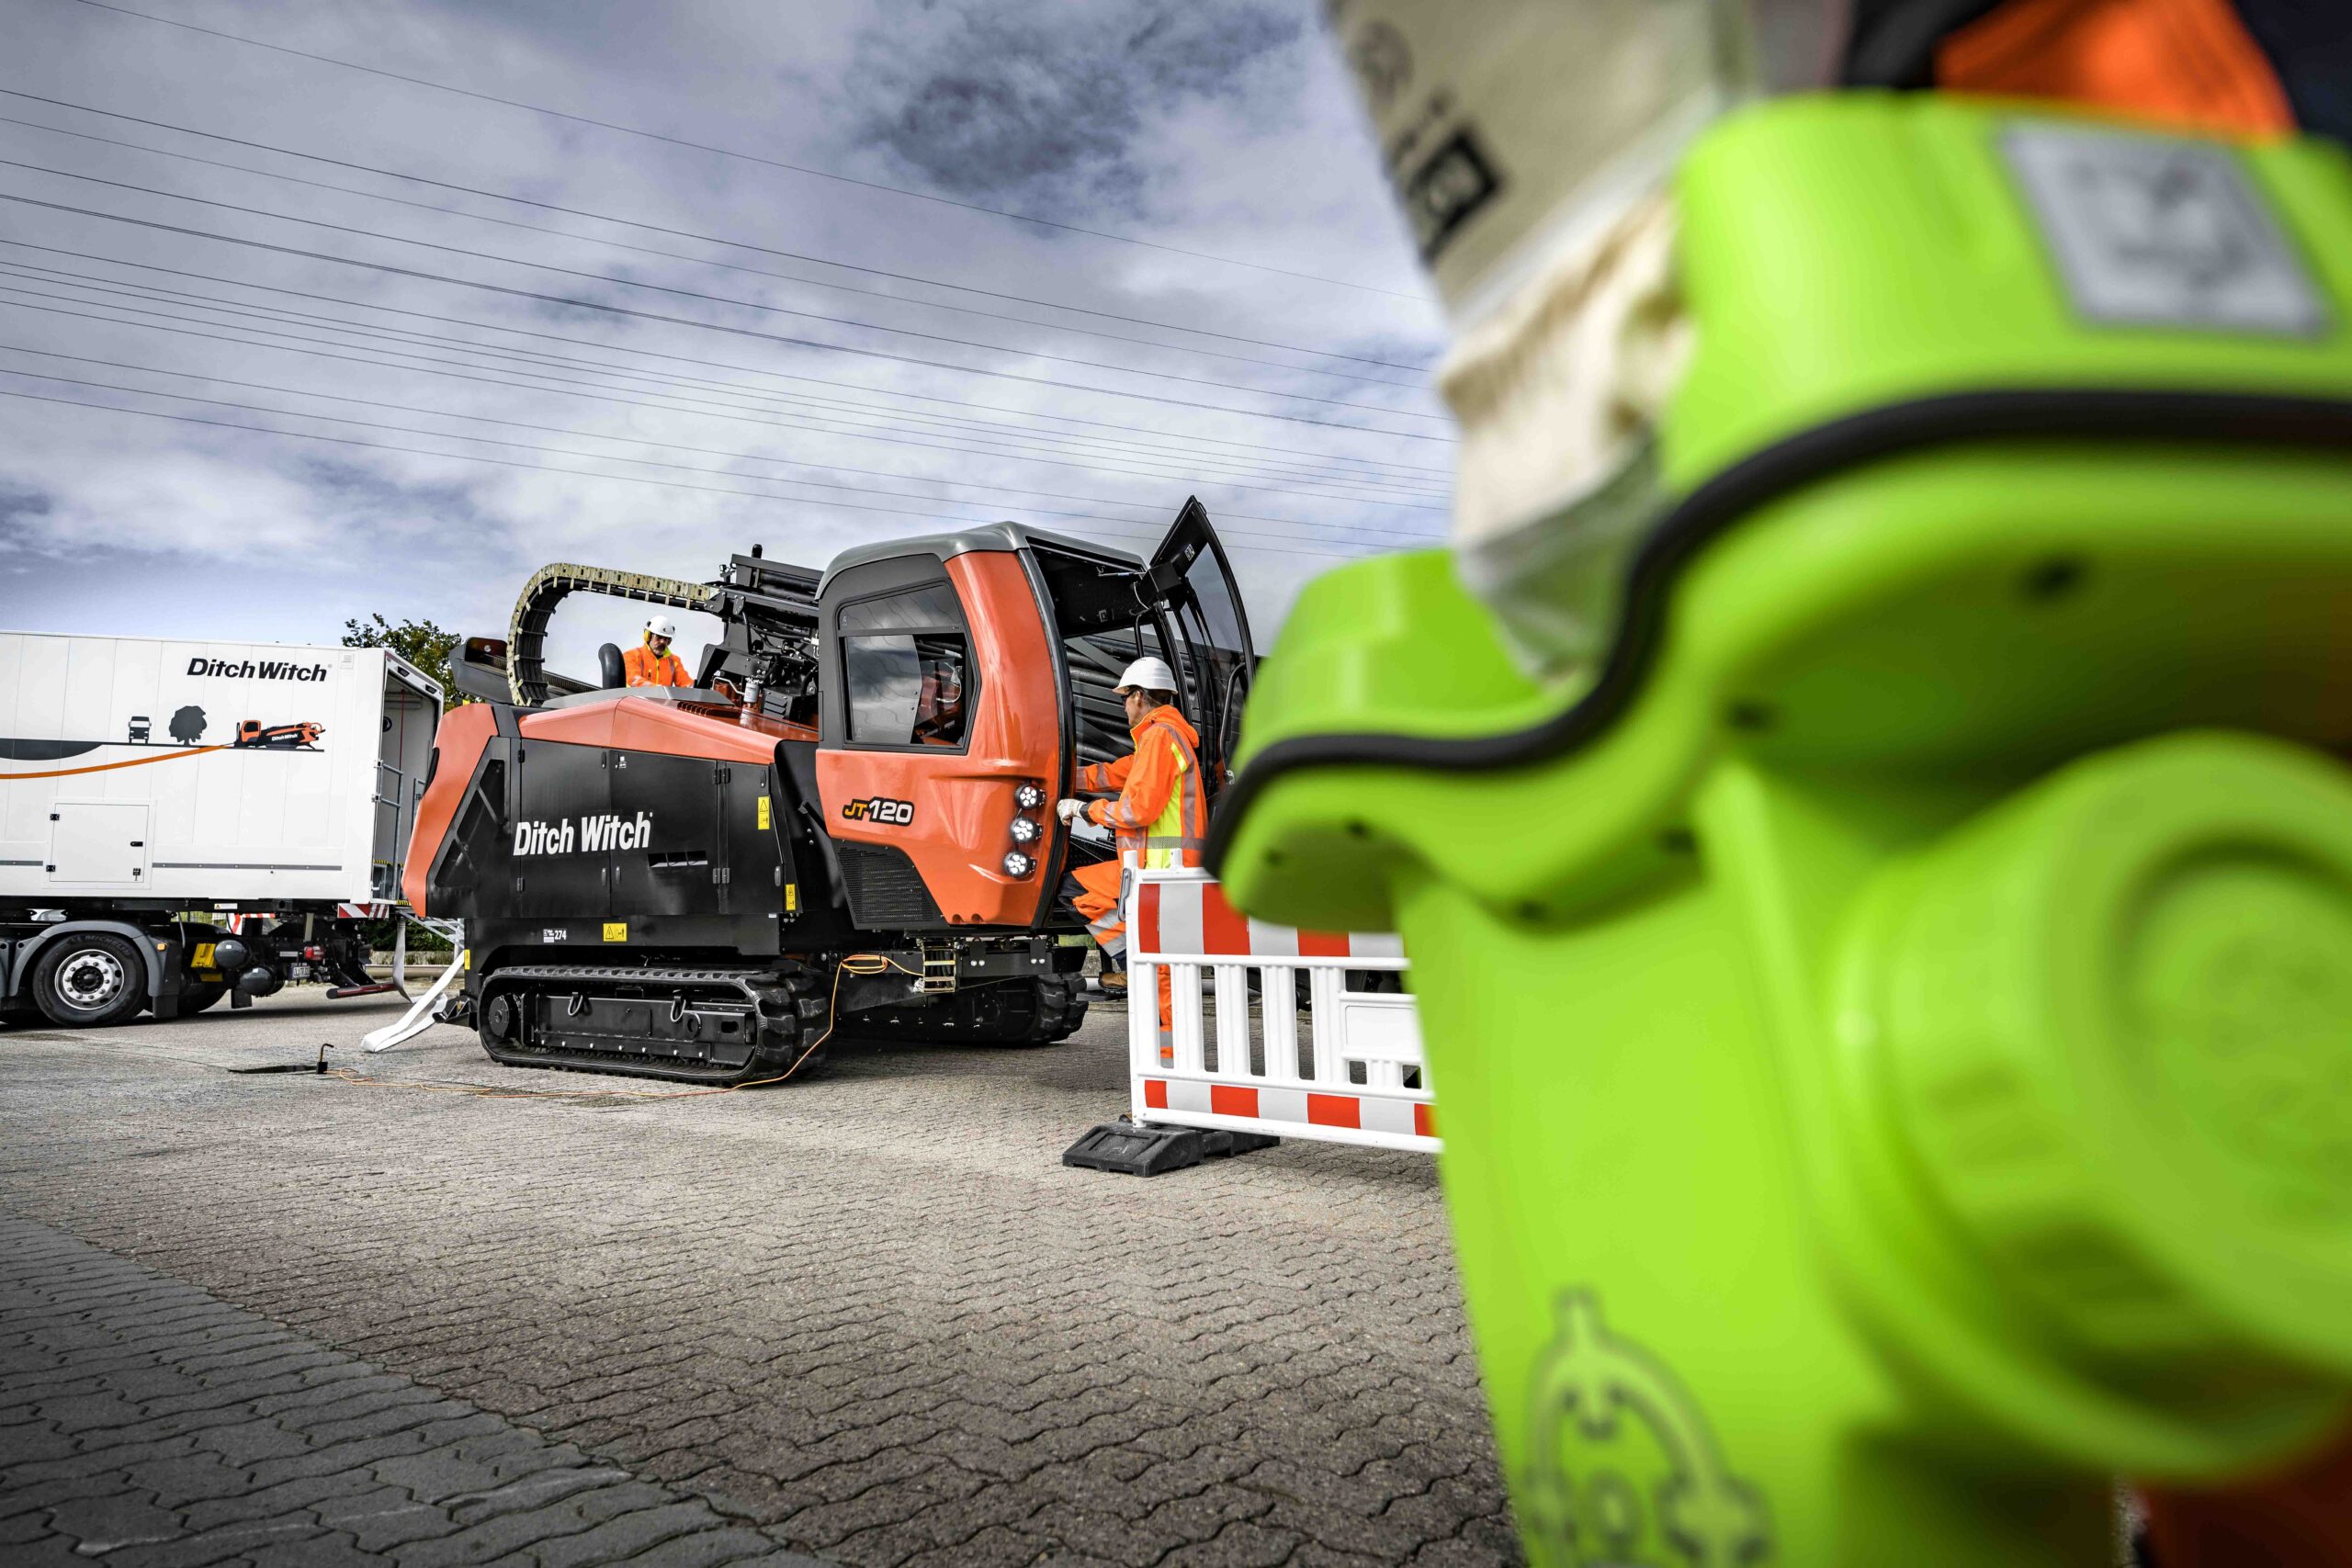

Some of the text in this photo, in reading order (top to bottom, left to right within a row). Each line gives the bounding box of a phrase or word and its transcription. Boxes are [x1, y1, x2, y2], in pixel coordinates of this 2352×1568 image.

[187, 658, 327, 682] Ditch Witch
[844, 799, 913, 824] JT120
[513, 811, 651, 856] Ditch Witch
[554, 930, 567, 941] 274
